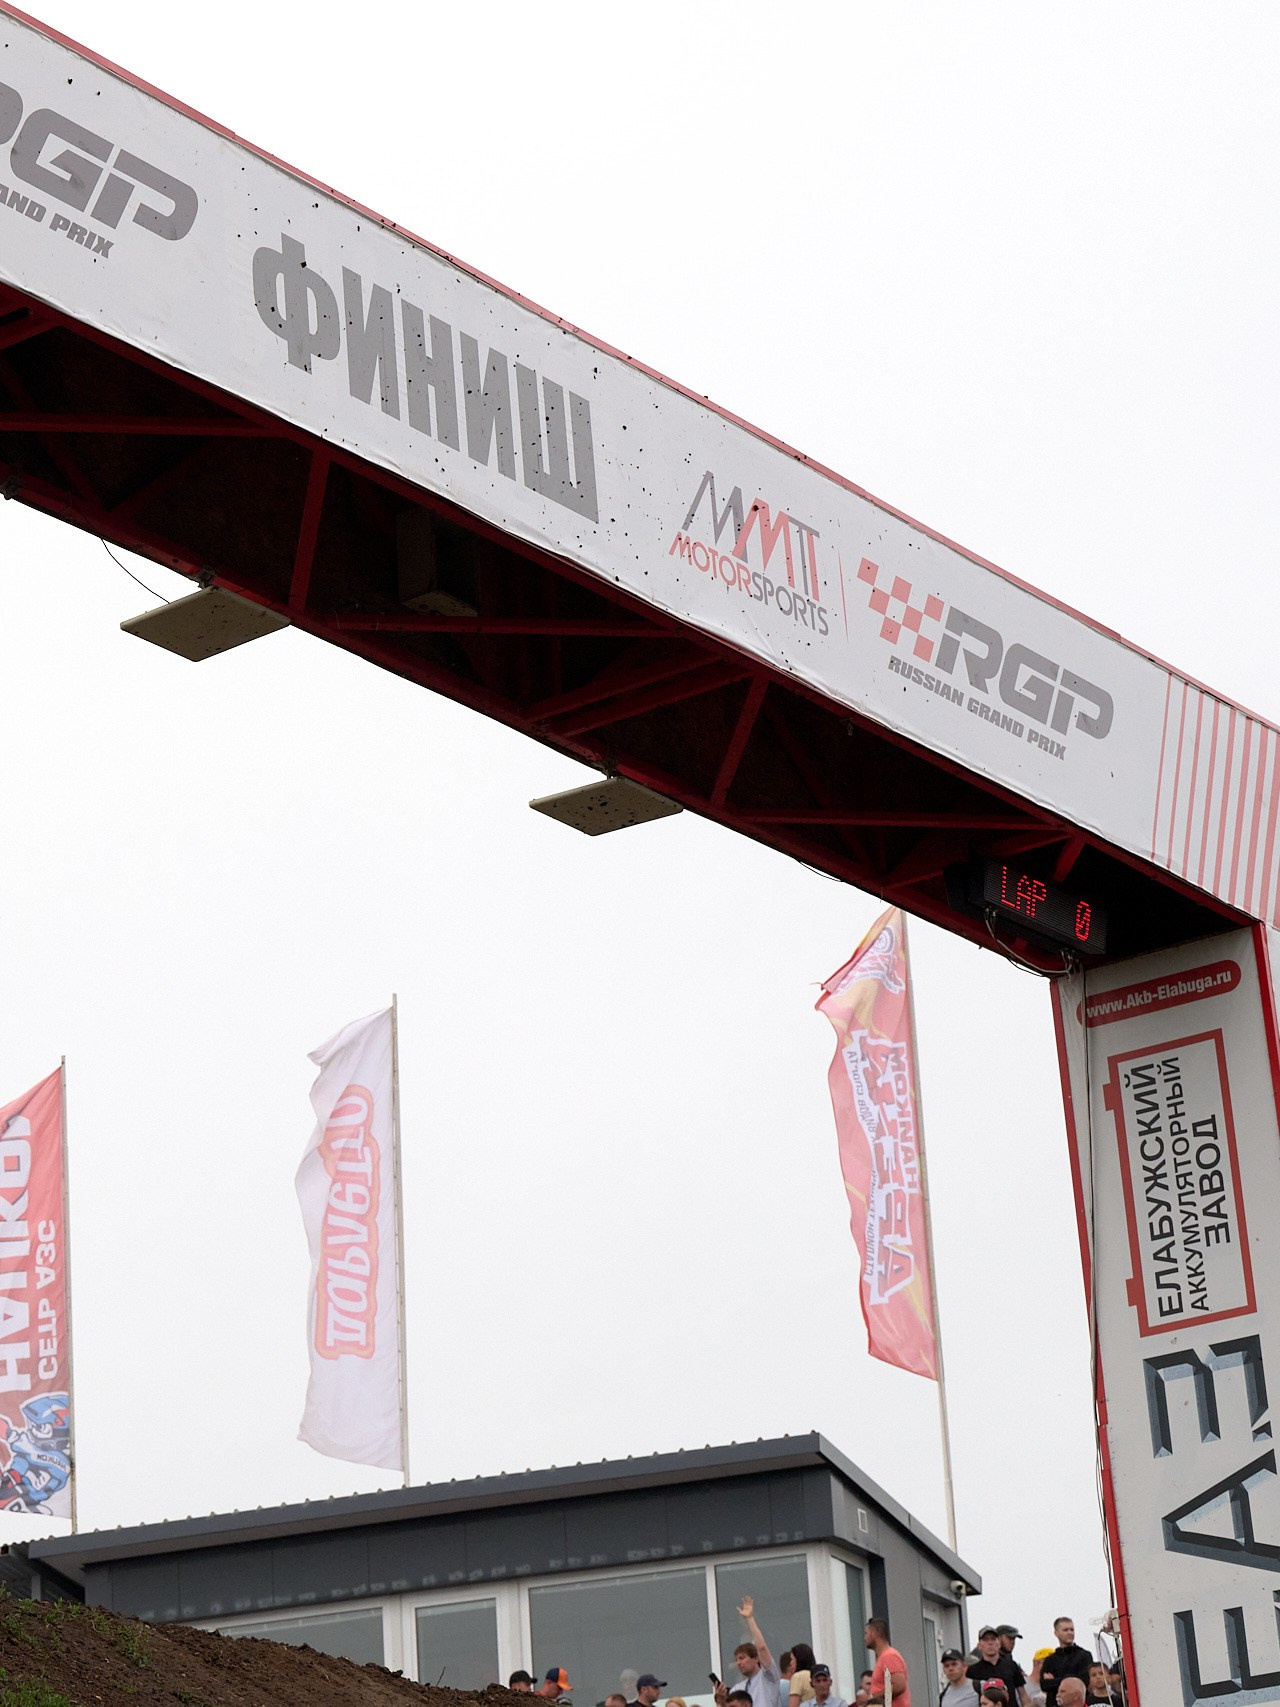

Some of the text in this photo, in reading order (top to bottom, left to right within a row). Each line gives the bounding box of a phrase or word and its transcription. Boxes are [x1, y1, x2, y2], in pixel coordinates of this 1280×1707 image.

[49, 213, 115, 258] PRIX
[252, 232, 600, 525] ФИНИШ
[669, 531, 829, 636] MOTORSPORTS
[888, 655, 1067, 761] RUSSIAN GRAND PRIX
[935, 606, 1115, 740] RGP
[1001, 865, 1092, 941] LAP 0
[1086, 970, 1232, 1018] www.Akb-Elabuga.ru
[1124, 1062, 1184, 1318] ЕЛАБУЖСКИЙ
[1156, 1057, 1209, 1312] АККУМУЛЯТОРНЫЙ
[1192, 1114, 1231, 1247] ЗАВОД
